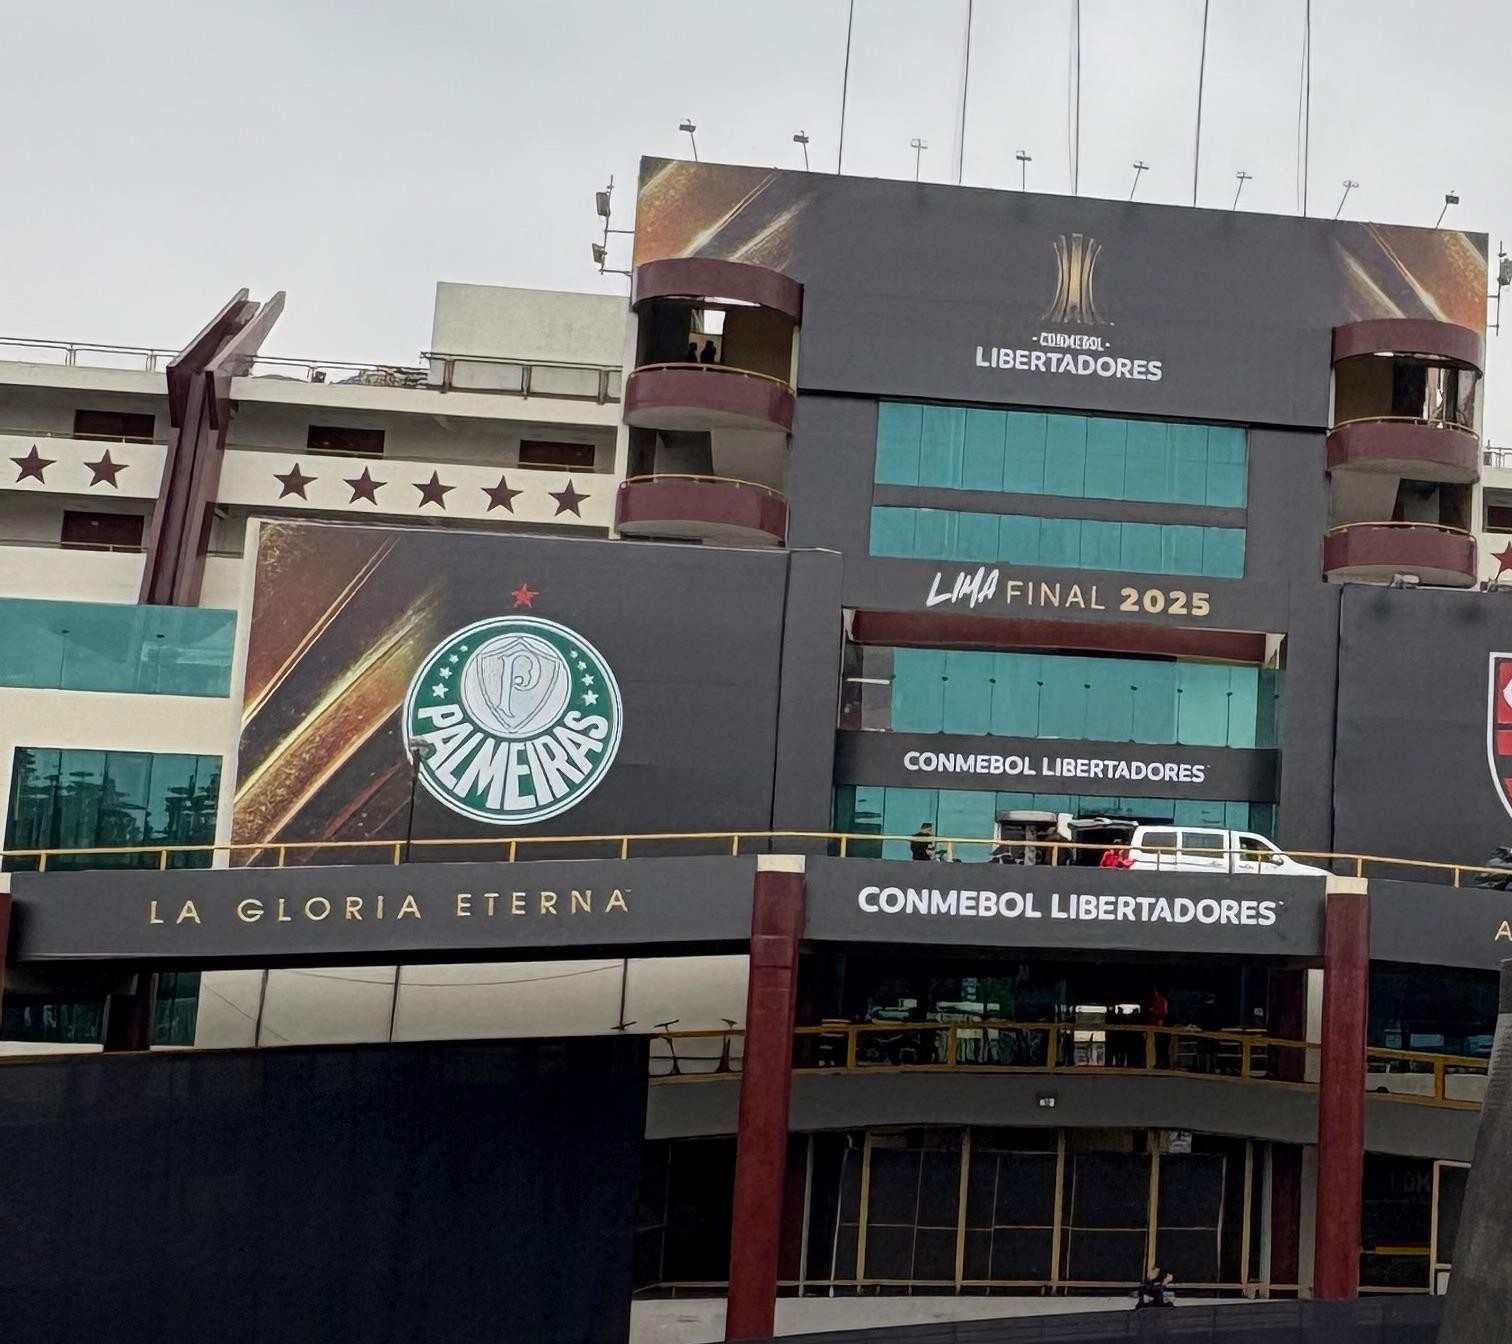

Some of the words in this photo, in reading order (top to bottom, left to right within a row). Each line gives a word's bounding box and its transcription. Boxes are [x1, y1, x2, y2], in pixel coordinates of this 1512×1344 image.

[976, 346, 1162, 381] LIBERTADORES
[926, 566, 1000, 609] LIMA
[1007, 580, 1105, 610] FINAL
[1119, 587, 1210, 616] 2025
[417, 703, 608, 810] PALMEIRAS
[903, 751, 1037, 775] CONMEBOL
[1042, 757, 1206, 783] LIBERTADORES
[149, 900, 201, 925] LA
[236, 894, 422, 923] GLORIA
[456, 889, 629, 917] ETERNA
[857, 886, 1042, 919] CONMEBOL
[1051, 893, 1277, 926] LIBERTADORES
